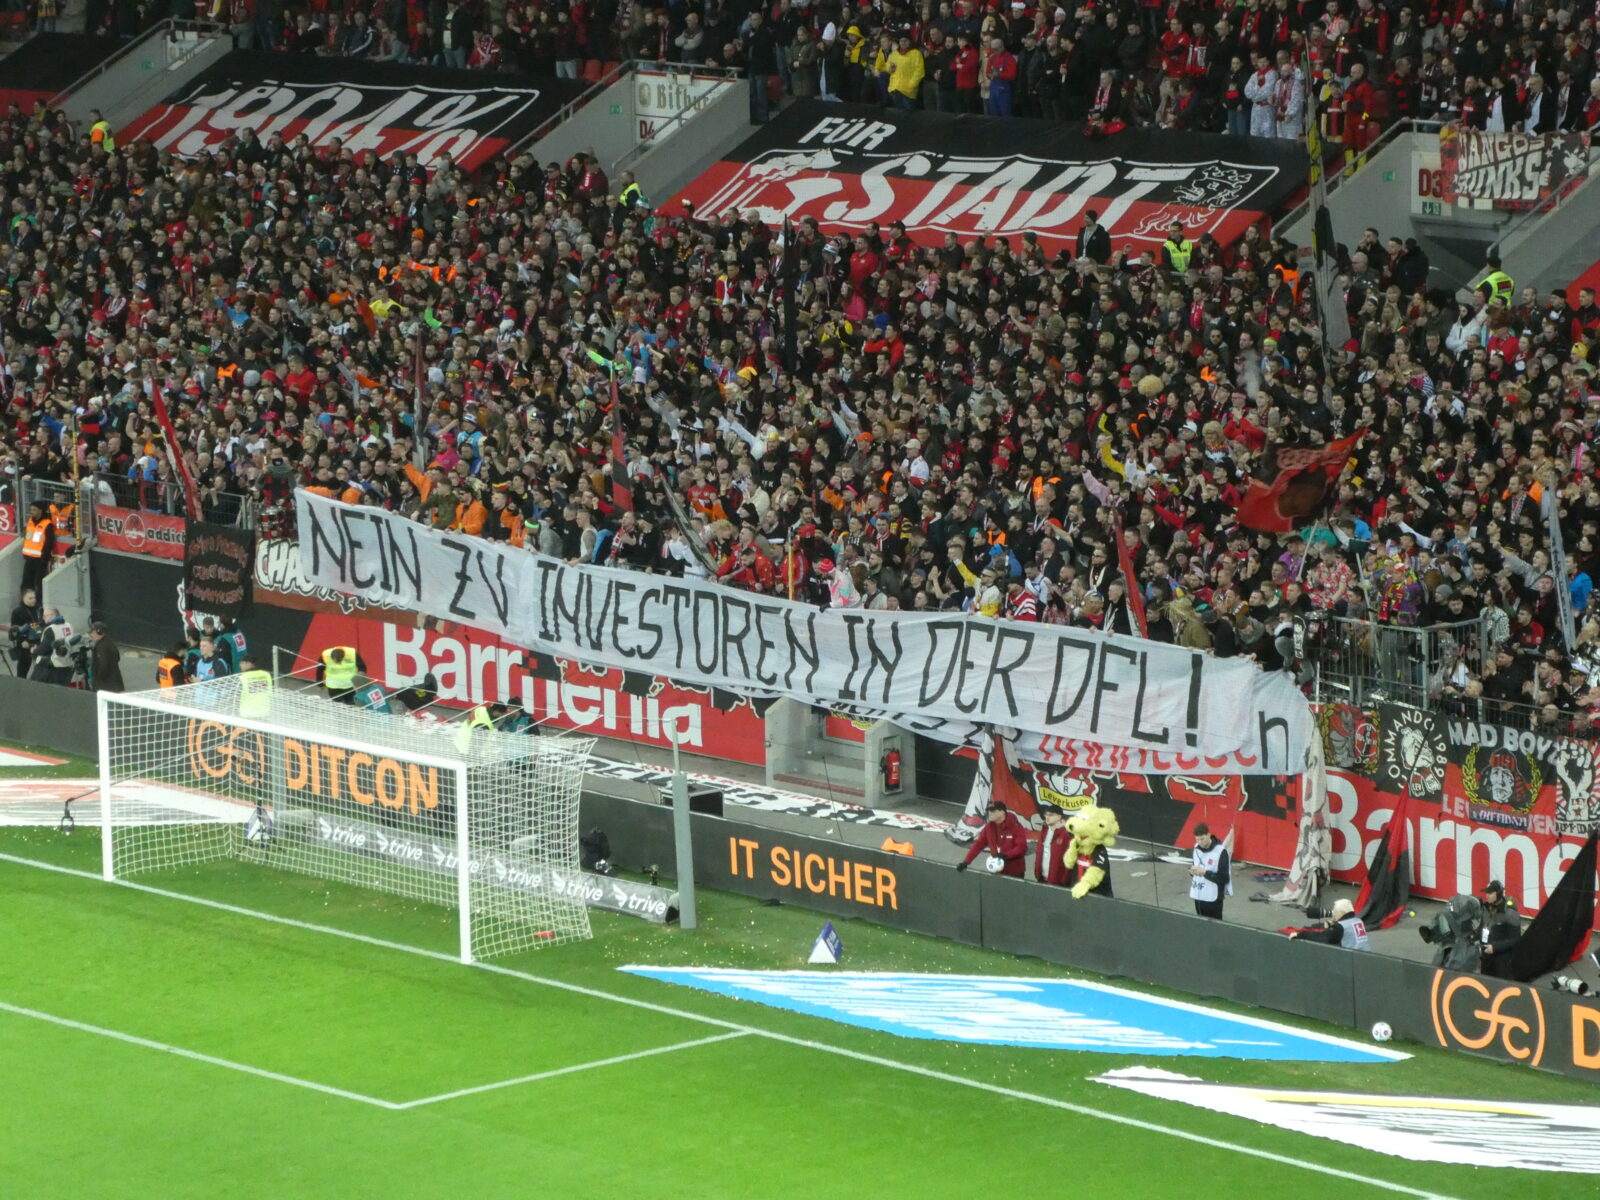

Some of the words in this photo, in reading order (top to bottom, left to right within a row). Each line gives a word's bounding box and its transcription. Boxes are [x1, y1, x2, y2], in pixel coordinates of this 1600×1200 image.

[798, 116, 896, 147] FÜR
[832, 154, 1198, 231] STADT
[1418, 168, 1443, 199] D3
[97, 515, 123, 535] LEV
[306, 501, 422, 602] NEIN
[537, 560, 820, 694] INVESTOREN
[838, 614, 904, 704] IN
[918, 621, 1036, 717] DER
[1448, 721, 1498, 748] MAD
[1433, 733, 1448, 778] 1989
[283, 738, 438, 815] DITCON
[1042, 788, 1090, 809] Leverkusen
[329, 827, 366, 847] trive
[385, 841, 423, 861] trive
[445, 854, 481, 874] trve
[730, 837, 759, 878] IT
[770, 846, 898, 910] SICHER
[506, 867, 542, 888] trive
[563, 880, 604, 901] trive
[624, 893, 667, 915] trive
